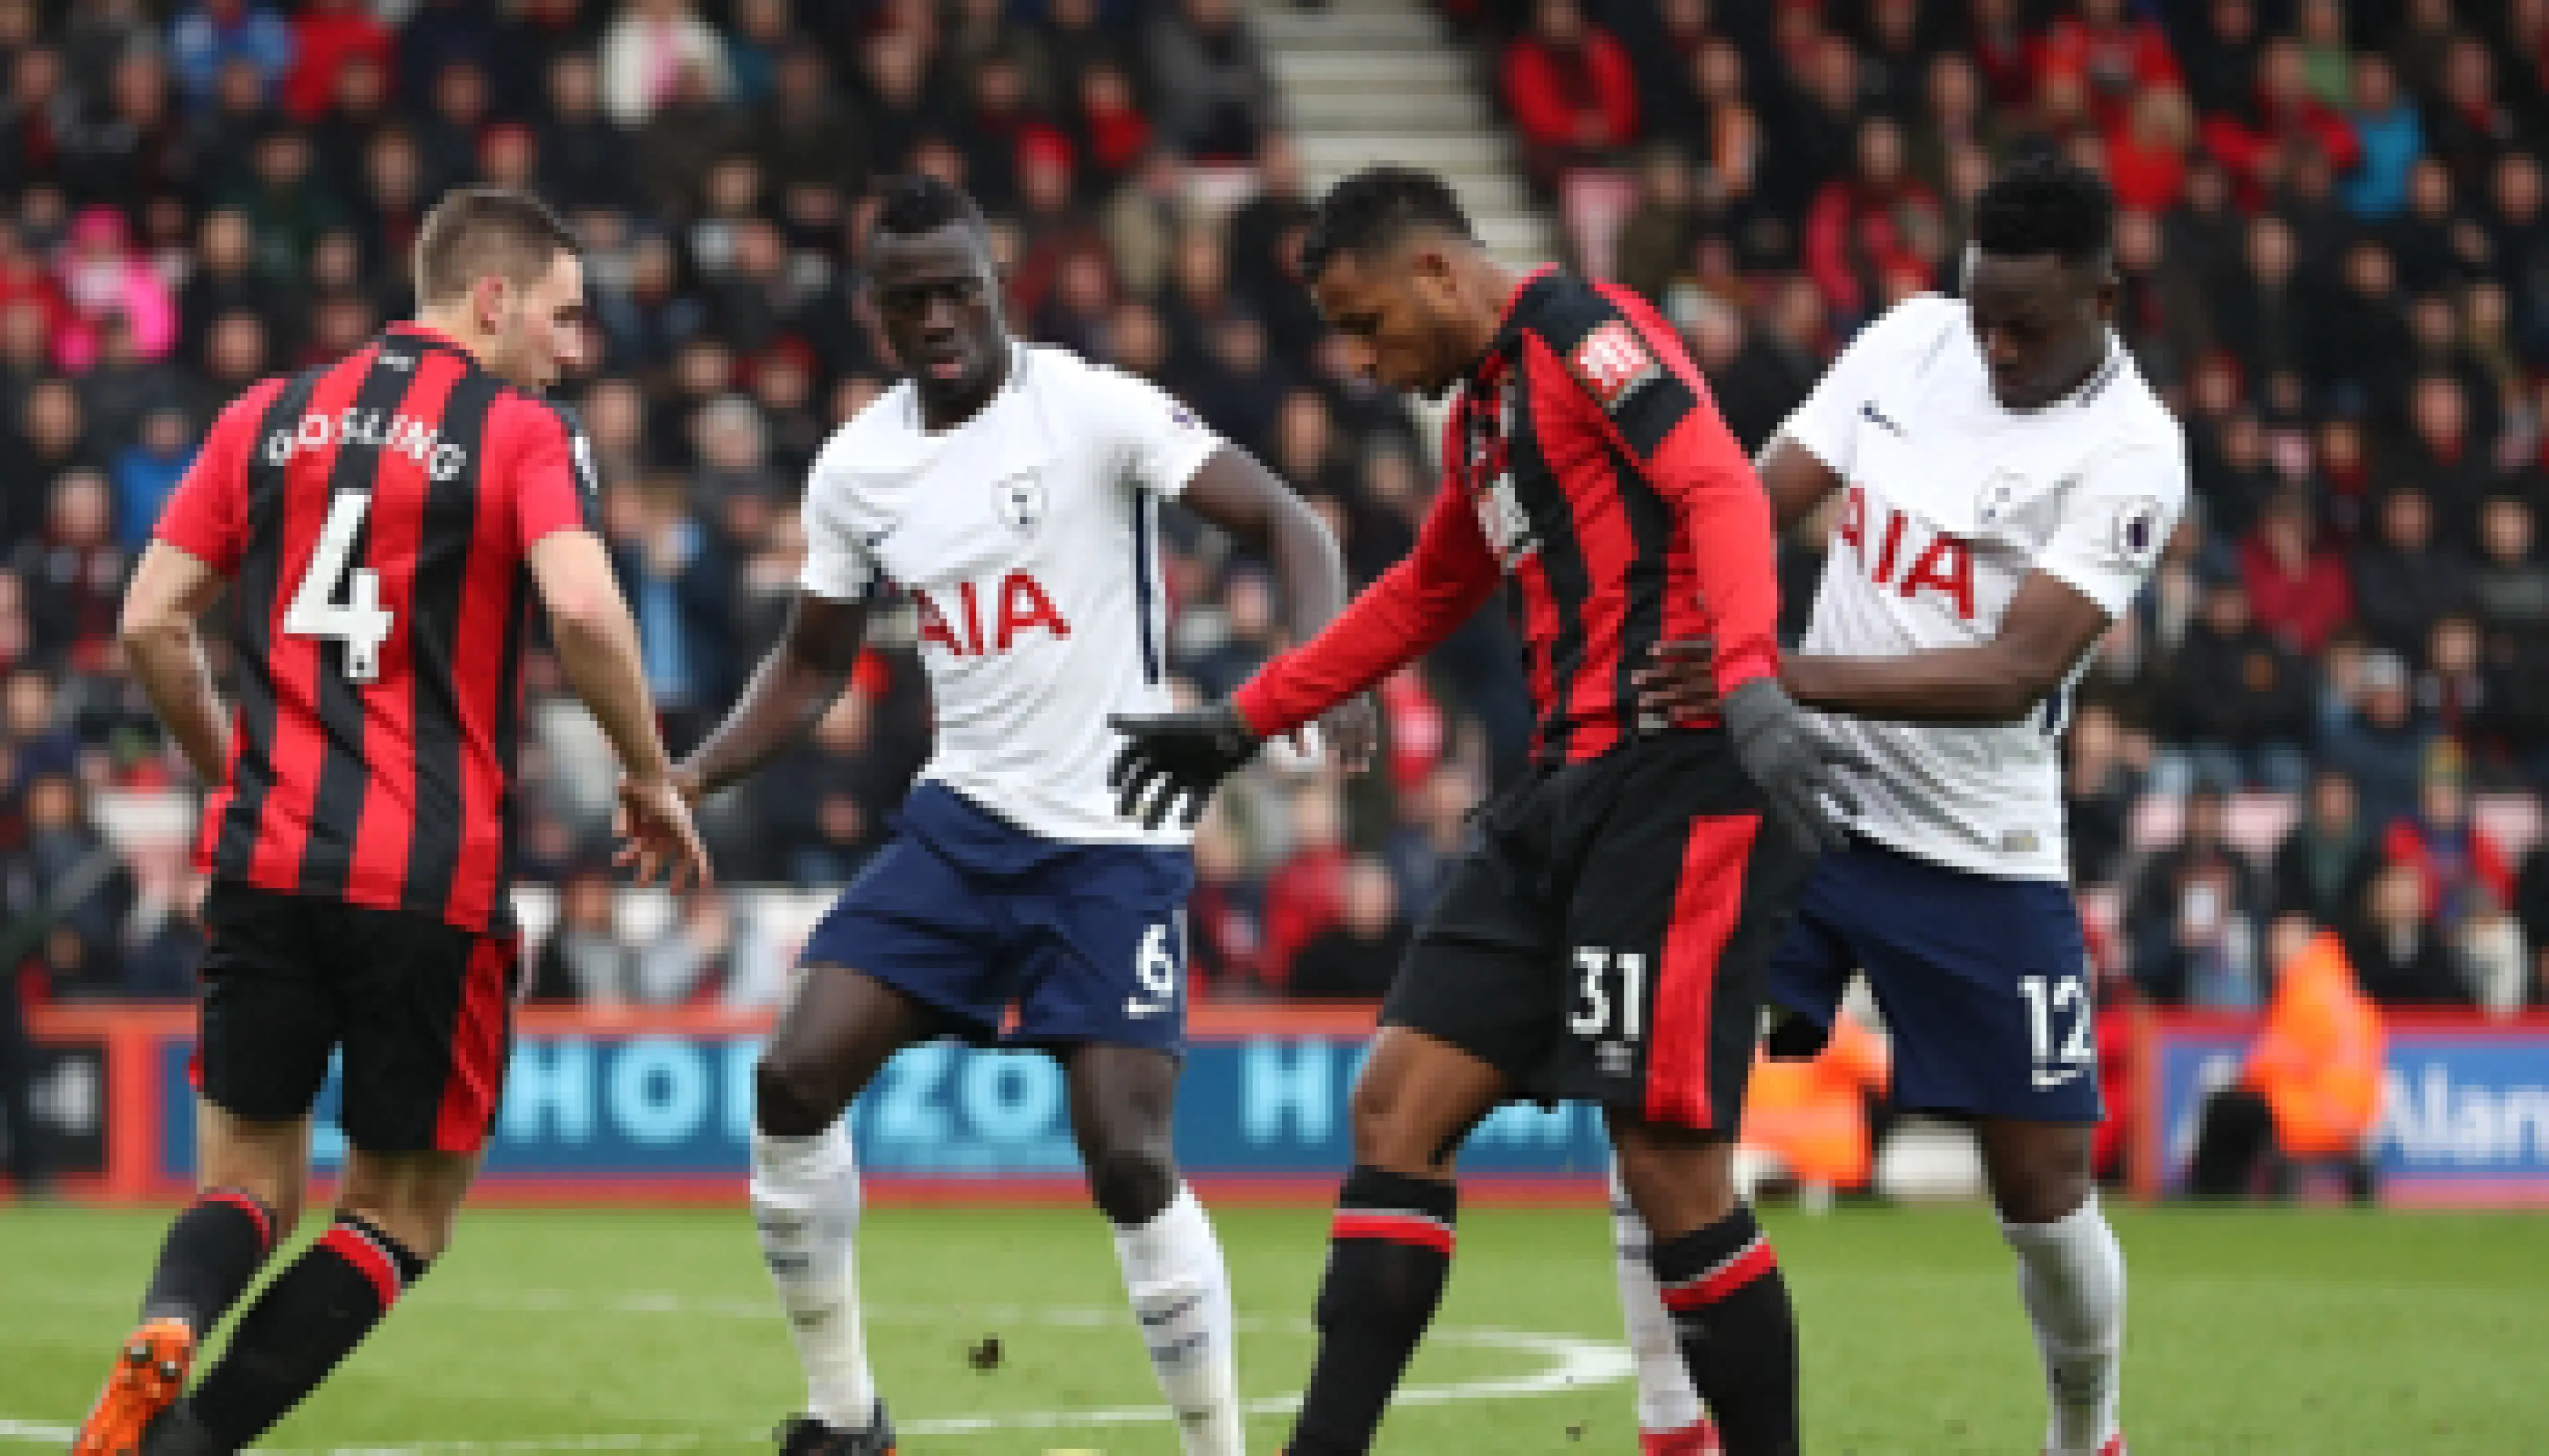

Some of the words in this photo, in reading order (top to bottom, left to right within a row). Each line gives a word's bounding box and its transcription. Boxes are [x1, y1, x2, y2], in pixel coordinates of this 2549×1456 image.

[284, 488, 394, 684] 4
[1836, 482, 1974, 620] AIA
[910, 568, 1071, 656] AIA
[1136, 924, 1174, 998] 6
[1569, 946, 1647, 1041] 31
[2017, 975, 2096, 1064] 12
